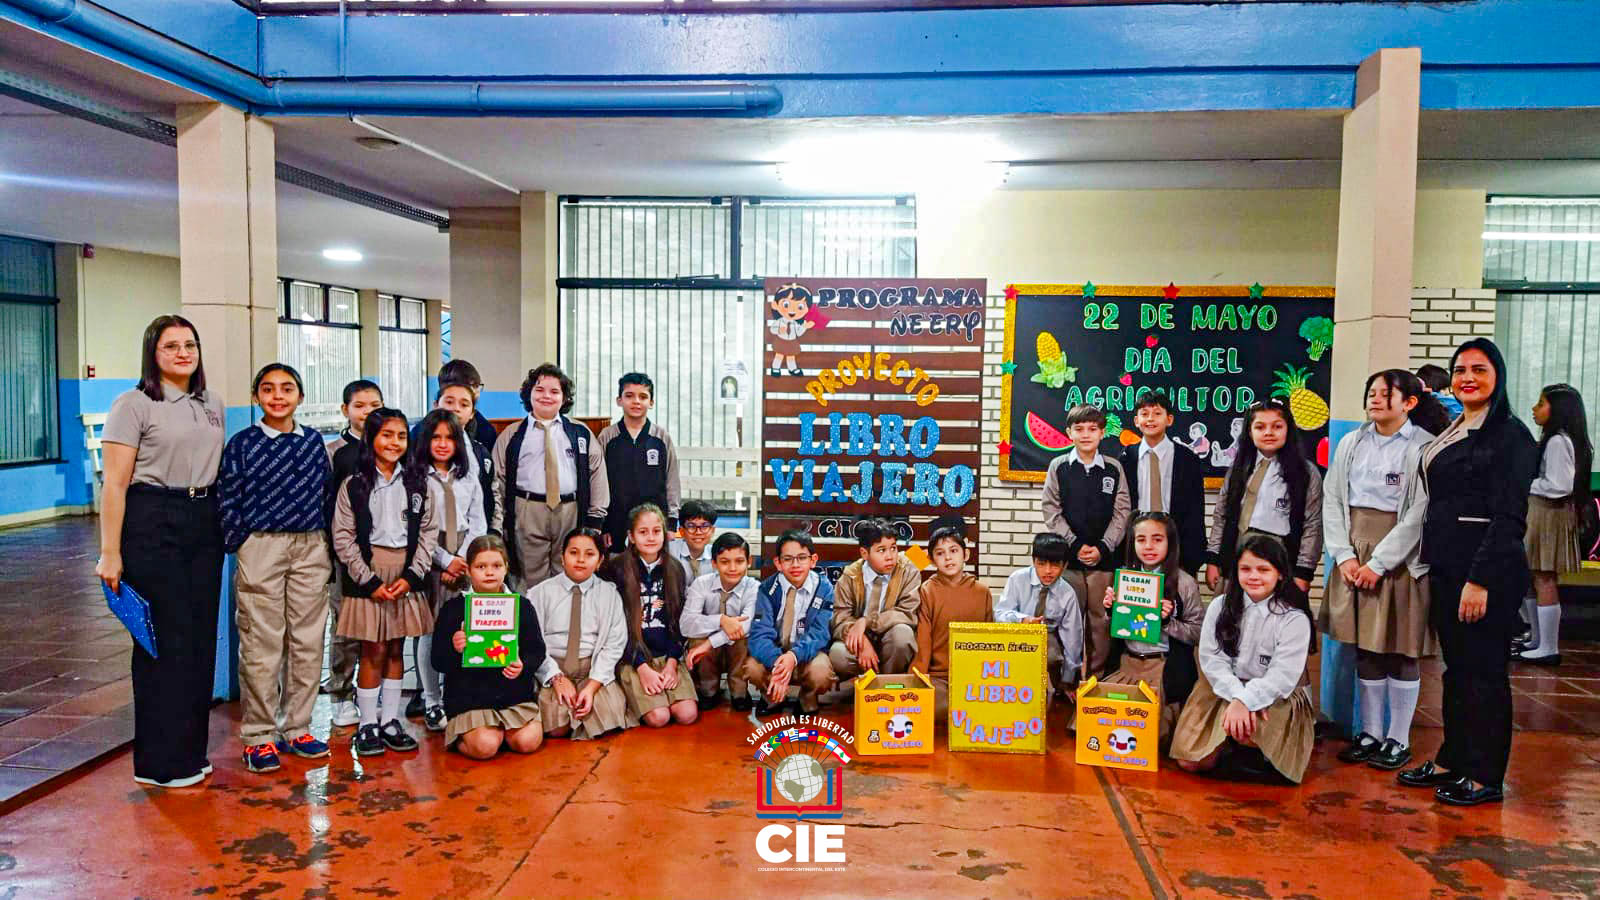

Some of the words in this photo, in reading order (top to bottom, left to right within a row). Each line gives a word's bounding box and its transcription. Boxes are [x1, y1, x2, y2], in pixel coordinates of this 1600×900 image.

[818, 286, 983, 310] PROGRAMA
[1083, 303, 1120, 330] 22
[1140, 303, 1175, 330] DE
[1191, 304, 1278, 331] MAYO
[1192, 347, 1243, 374] DEL
[806, 352, 940, 407] PROYECTO
[798, 412, 940, 458] LIBRO
[769, 458, 975, 508] VIAJERO
[981, 661, 1010, 678] MI
[965, 684, 1033, 703] LIBRO
[952, 709, 1042, 745] VIAJERO
